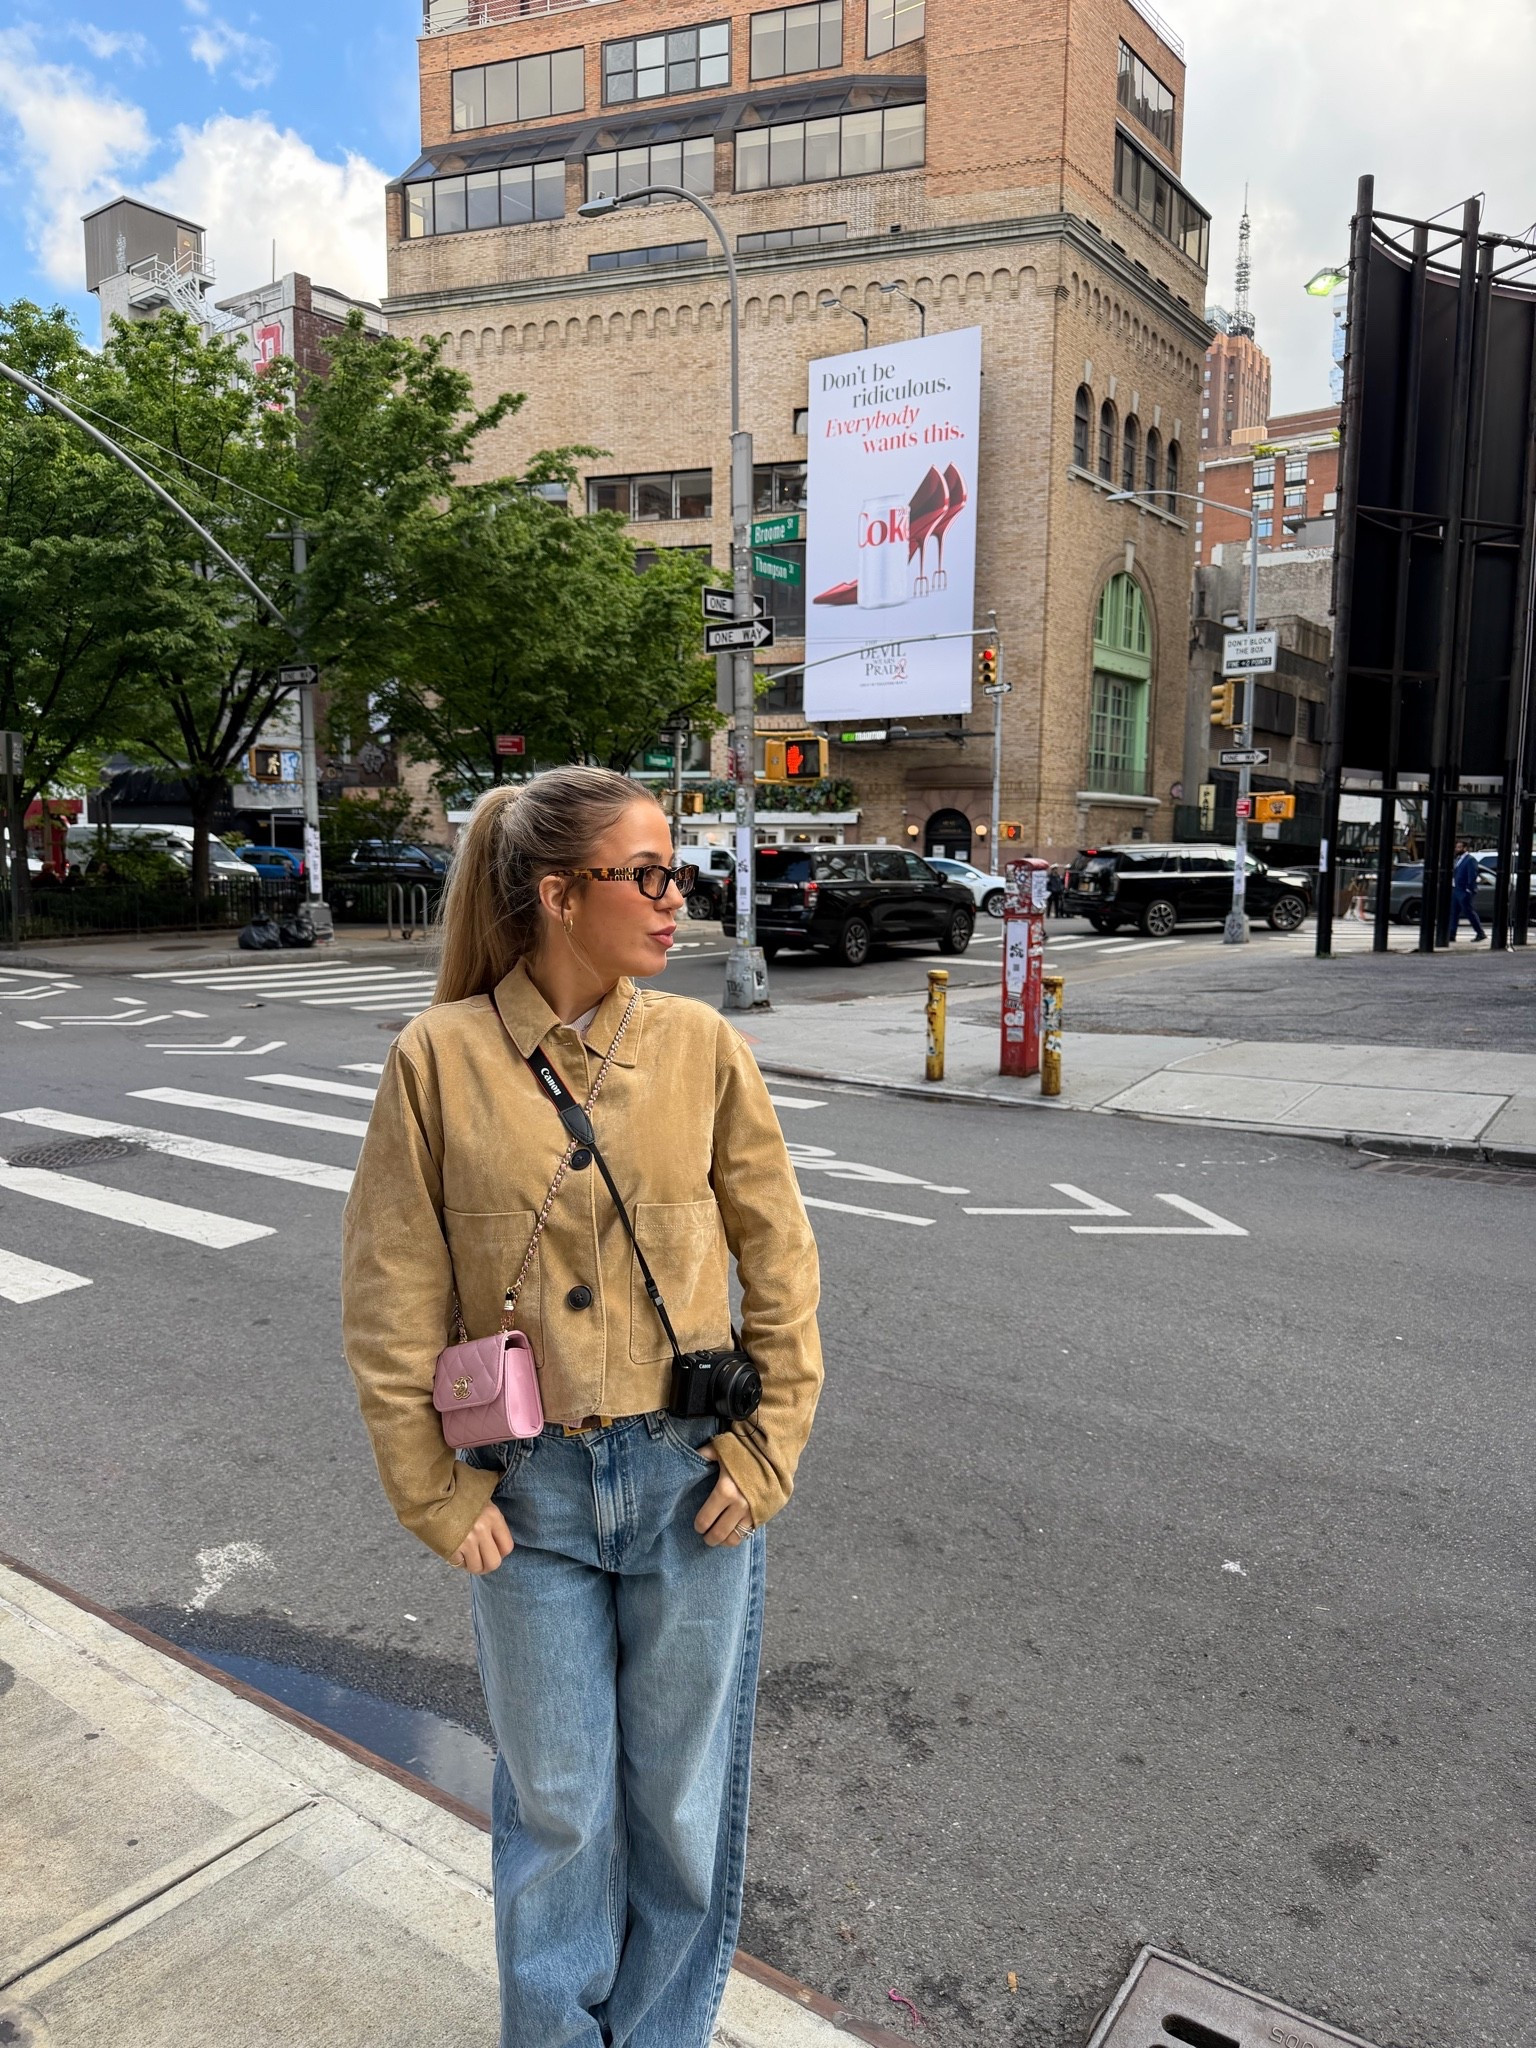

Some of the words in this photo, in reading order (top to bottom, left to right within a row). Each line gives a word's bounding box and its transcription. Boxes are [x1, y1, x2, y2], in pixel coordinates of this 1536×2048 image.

[822, 365, 866, 392] Don't
[873, 363, 895, 381] be
[852, 376, 952, 409] ridiculous.
[825, 404, 921, 438] Everybody
[863, 430, 918, 454] wants
[923, 421, 965, 442] this.
[755, 525, 786, 543] Broome
[755, 556, 788, 579] Thompson
[710, 597, 727, 611] ONE
[714, 631, 734, 644] ONE
[742, 627, 763, 640] WAY
[1227, 638, 1248, 648] DON'T
[1250, 636, 1272, 646] BLOCK
[860, 642, 906, 660] DEVIL
[1235, 646, 1248, 655] THE
[1250, 645, 1264, 654] BOX
[1224, 753, 1239, 761] ONE
[1245, 752, 1260, 761] WAY
[541, 1067, 562, 1096] Canon
